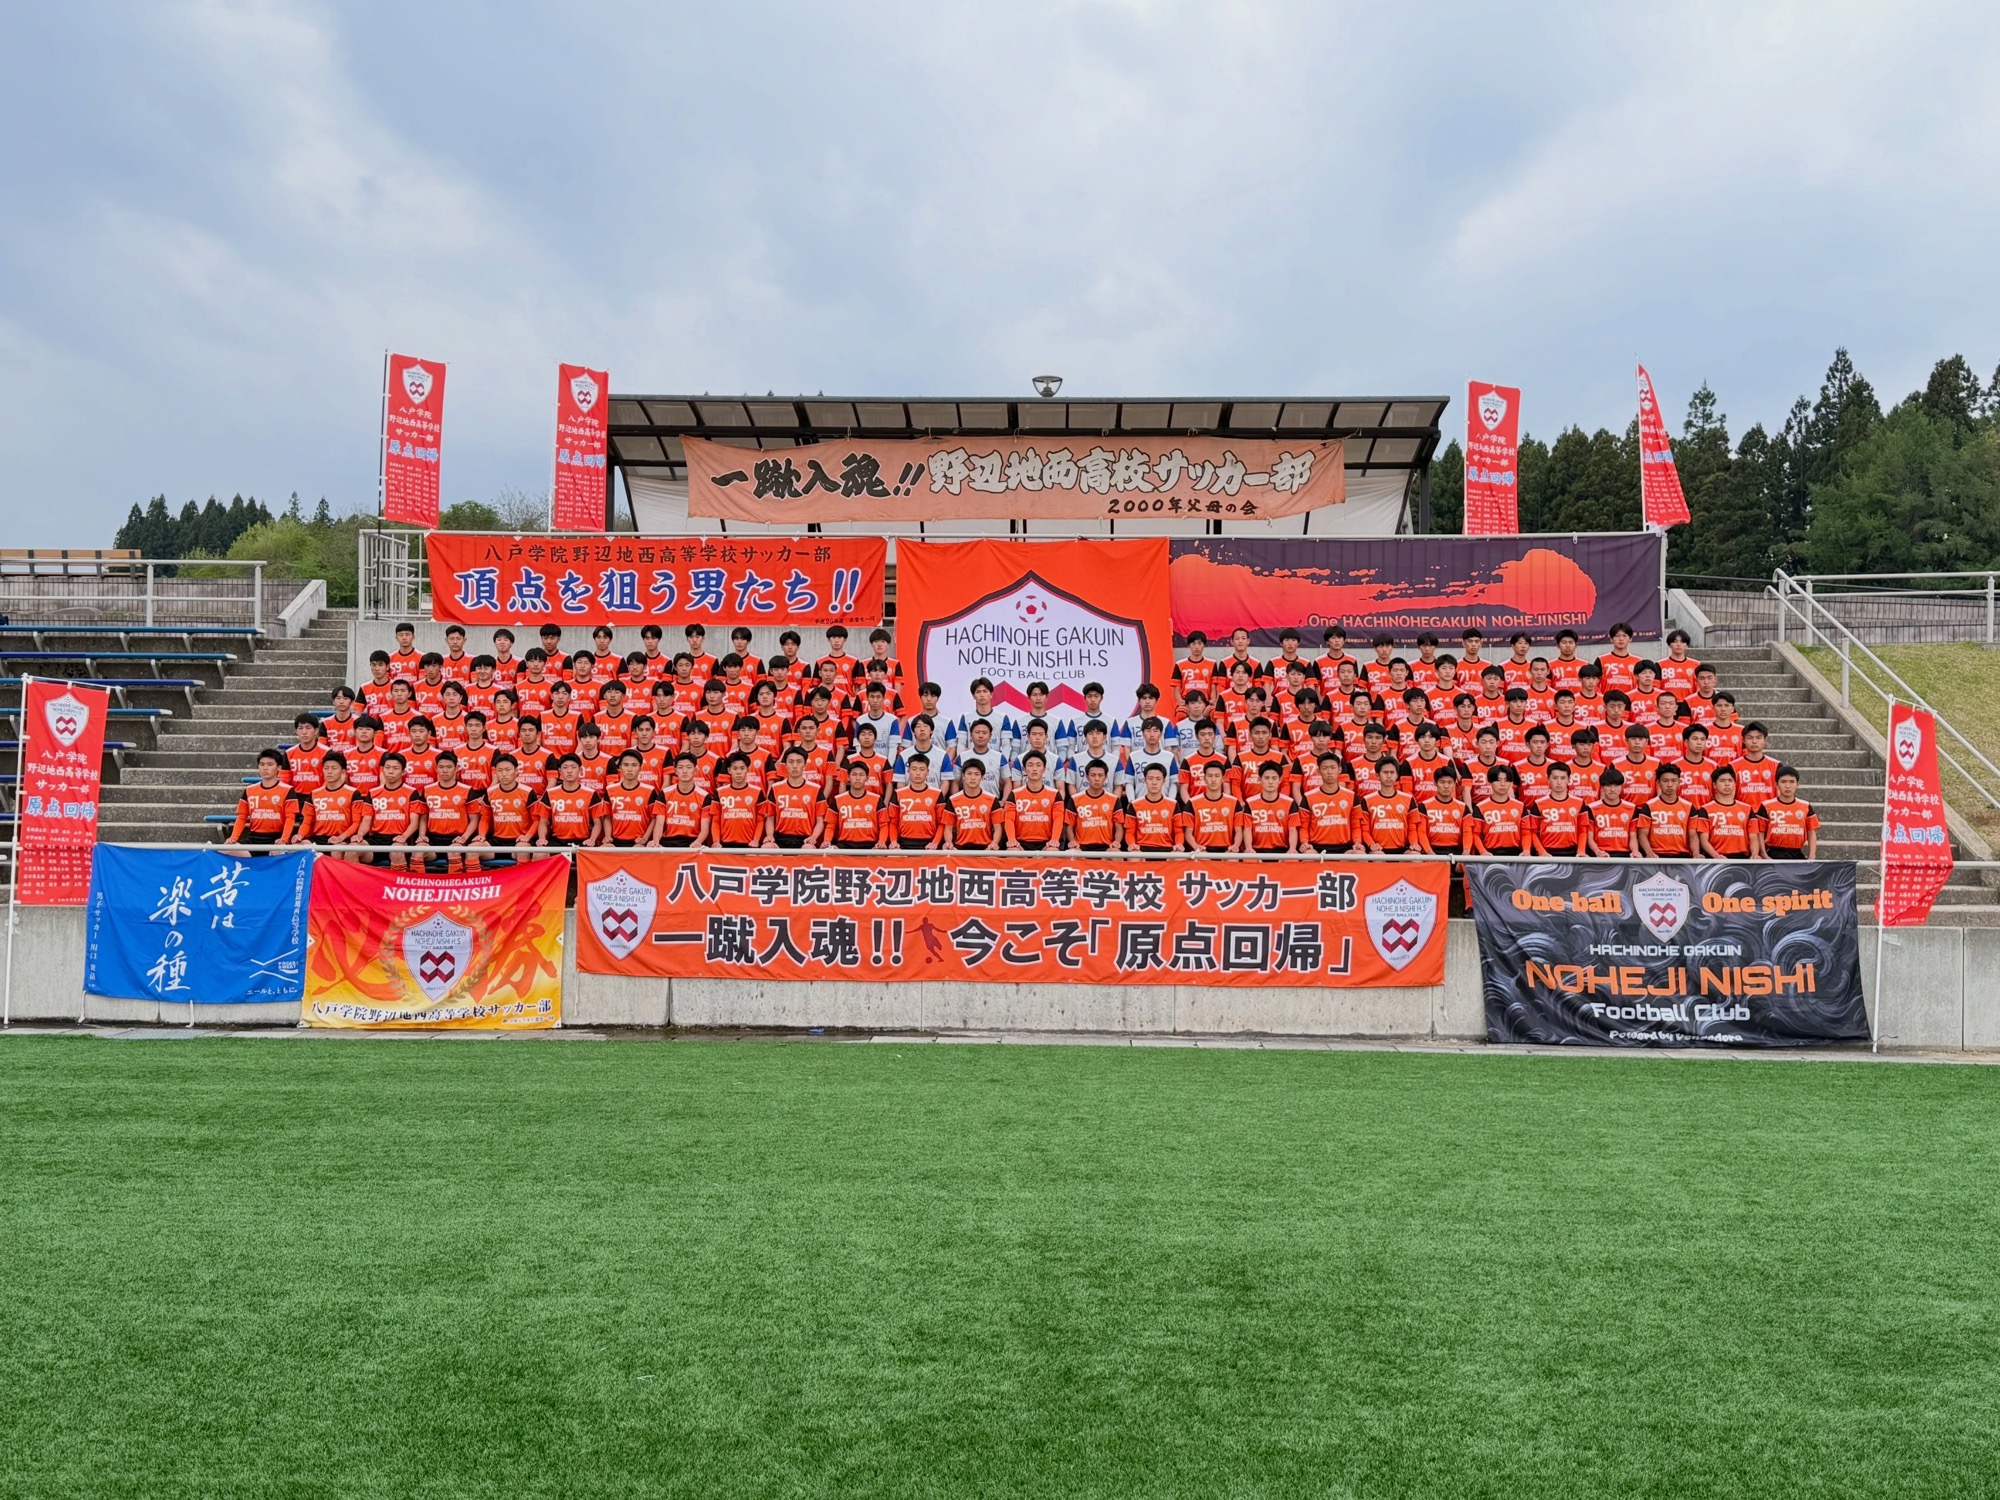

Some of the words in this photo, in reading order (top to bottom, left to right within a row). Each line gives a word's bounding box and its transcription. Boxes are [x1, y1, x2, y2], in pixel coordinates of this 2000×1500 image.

[399, 406, 433, 420] 八戸学院
[567, 415, 600, 428] 八戸学院
[395, 427, 434, 443] サッカー部
[564, 436, 602, 449] サッカー部
[387, 438, 439, 464] 原点回帰
[557, 448, 606, 469] 原点回帰
[928, 446, 1318, 495] 野辺地西高校サッカー部
[1107, 496, 1256, 515] 2000年父母の会
[484, 543, 832, 564] 八戸学院野辺地西高等学校サッカー部
[453, 566, 861, 614] 頂点を狙う男たち!!
[1308, 614, 1339, 627] One
[1342, 614, 1487, 629] HACHINOHEGAKUIN
[1491, 612, 1588, 628] NOHEJINISHI
[945, 623, 1050, 648] HACHINOHE
[1055, 626, 1125, 647] GAKUIN
[957, 646, 1021, 667] NOHEJI
[1027, 650, 1073, 669] NISHI
[1079, 650, 1109, 668] H.S
[1053, 669, 1085, 680] CLUB
[1182, 669, 1194, 680] 73
[1274, 667, 1286, 678] 86
[1553, 665, 1565, 678] 41
[1605, 663, 1618, 675] 75
[1662, 668, 1675, 679] 88
[1368, 672, 1380, 682] 82
[1181, 729, 1193, 740] 53
[41, 749, 88, 764] 八戸学院
[1356, 767, 1369, 779] 28
[36, 779, 90, 794] サッカー部
[25, 795, 96, 820] 原点回帰
[372, 798, 387, 809] 88
[552, 800, 564, 812] 78
[721, 796, 734, 808] 90
[778, 795, 788, 808] 51
[900, 799, 914, 811] 57
[1016, 799, 1030, 812] 87
[841, 806, 852, 818] 91
[956, 807, 969, 819] 93
[1078, 805, 1092, 817] 86
[1198, 809, 1211, 822] 15
[1253, 810, 1267, 823] 59
[1313, 804, 1327, 816] 67
[1371, 807, 1385, 818] 76
[1428, 810, 1442, 822] 54
[1484, 810, 1500, 823] 60
[1543, 808, 1559, 821] 58
[1137, 811, 1152, 823] 94
[1597, 815, 1609, 827] 81
[1651, 812, 1667, 823] 50
[1709, 813, 1727, 824] 73
[1770, 811, 1785, 823] 92
[396, 876, 492, 887] HACHINOHEGAKUIN
[667, 864, 1164, 911] 八戸学院野辺地西高等学校
[1177, 870, 1359, 912] サッカー部
[200, 860, 250, 930] 苦は
[382, 885, 502, 902] NOHEJINISHI
[1511, 889, 1565, 912] One
[1570, 892, 1623, 914] ball
[1702, 891, 1756, 914] One
[1762, 888, 1834, 917] spirit
[147, 876, 193, 993] 楽の種
[947, 916, 1352, 976] 今こそ「原点回帰」
[1589, 944, 1679, 957] HACHINOHE
[1683, 944, 1742, 957] GAKUIN
[1525, 960, 1687, 997] NOHEJI
[1700, 962, 1816, 996] NISHI
[1589, 1002, 1690, 1021] Football
[1694, 1002, 1751, 1021] Club
